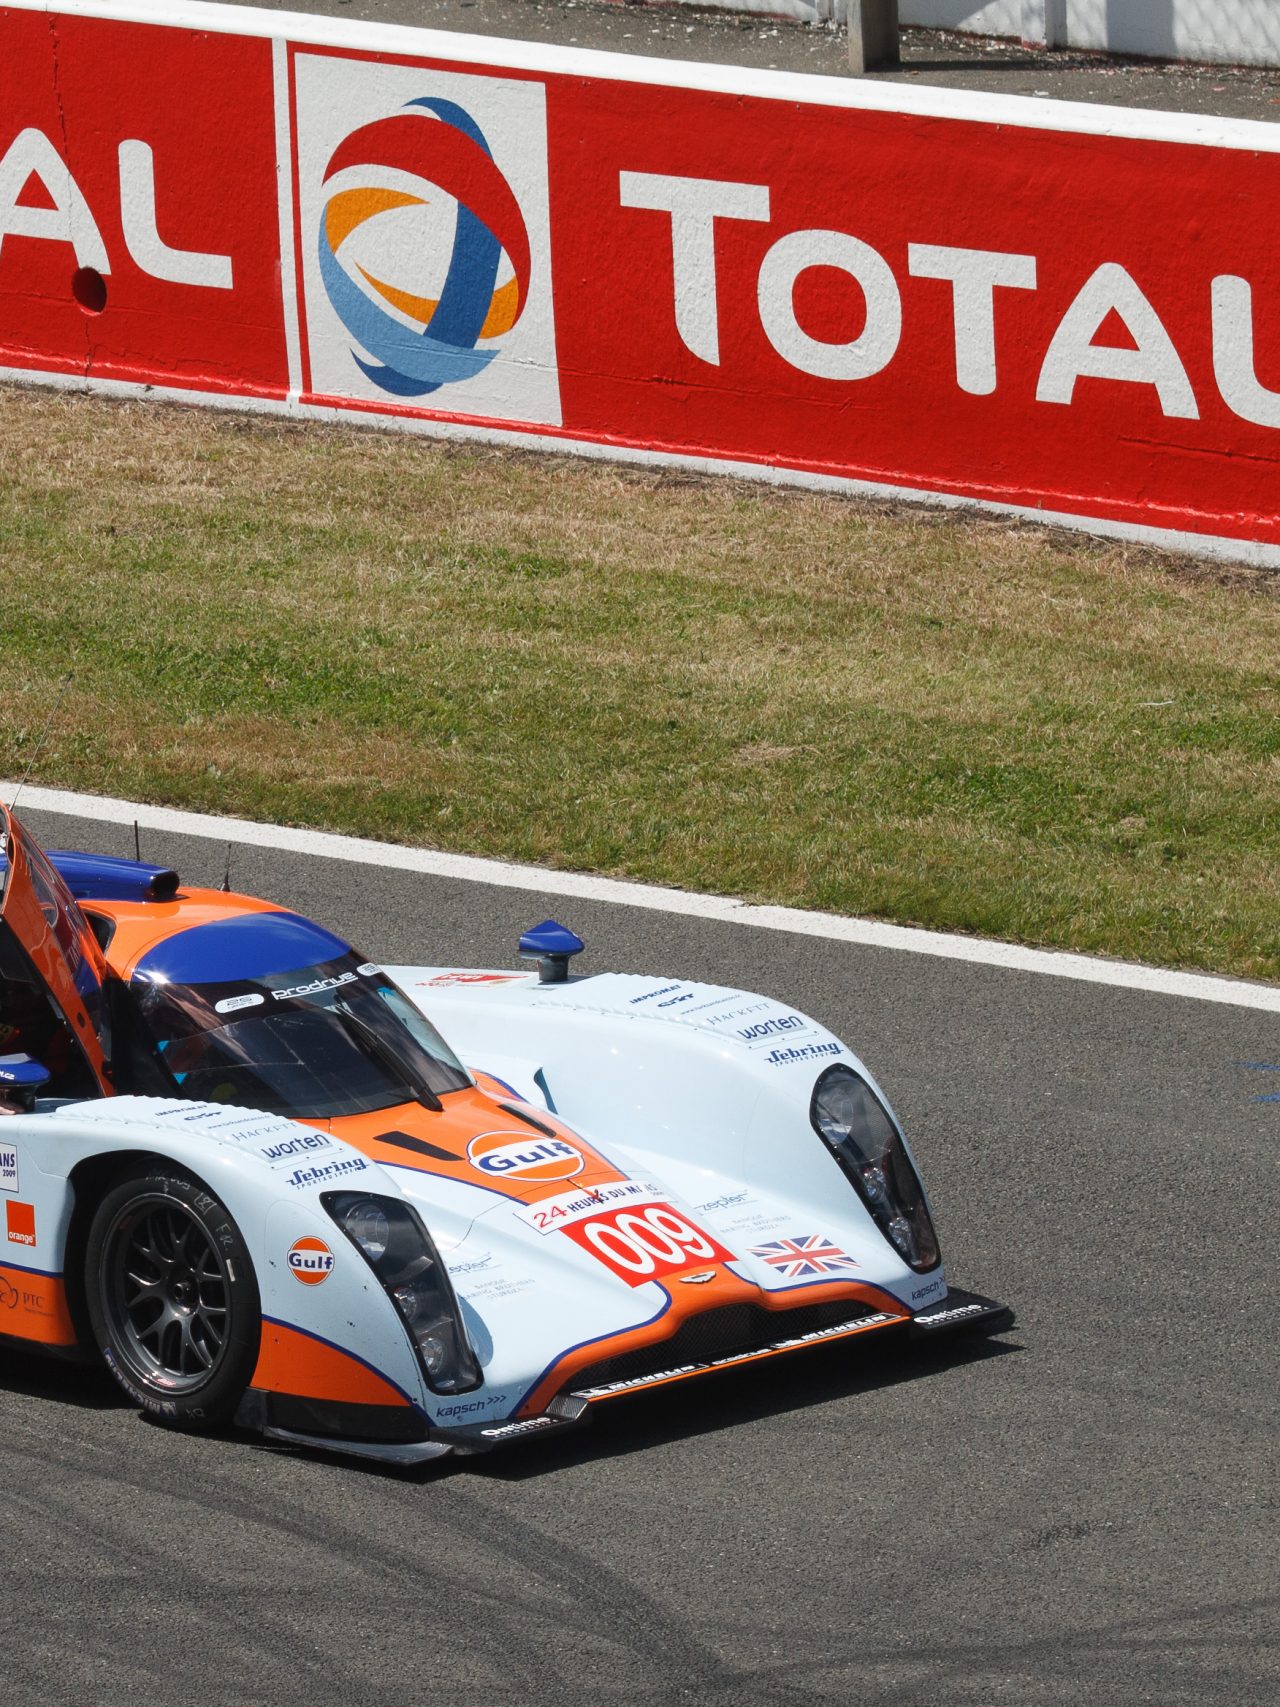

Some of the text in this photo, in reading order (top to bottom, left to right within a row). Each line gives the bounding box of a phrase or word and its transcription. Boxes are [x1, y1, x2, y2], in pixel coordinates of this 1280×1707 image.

[706, 1003, 771, 1026] HACKETT
[737, 1015, 803, 1040] worten
[763, 1042, 844, 1064] Sebring
[231, 1121, 298, 1143] HACKETT
[260, 1132, 330, 1160] worten
[478, 1141, 575, 1172] Gulf
[2, 1168, 16, 1177] 2009
[285, 1157, 370, 1187] Sebring
[532, 1205, 568, 1229] 24
[612, 1186, 626, 1199] DU
[8, 1231, 34, 1245] orange
[583, 1207, 716, 1275] 009
[289, 1252, 333, 1270] Gulf
[911, 1280, 940, 1302] kapsch
[800, 1314, 887, 1342] MICHELIN
[609, 1364, 696, 1391] MICHELIN
[436, 1400, 486, 1418] kapsch
